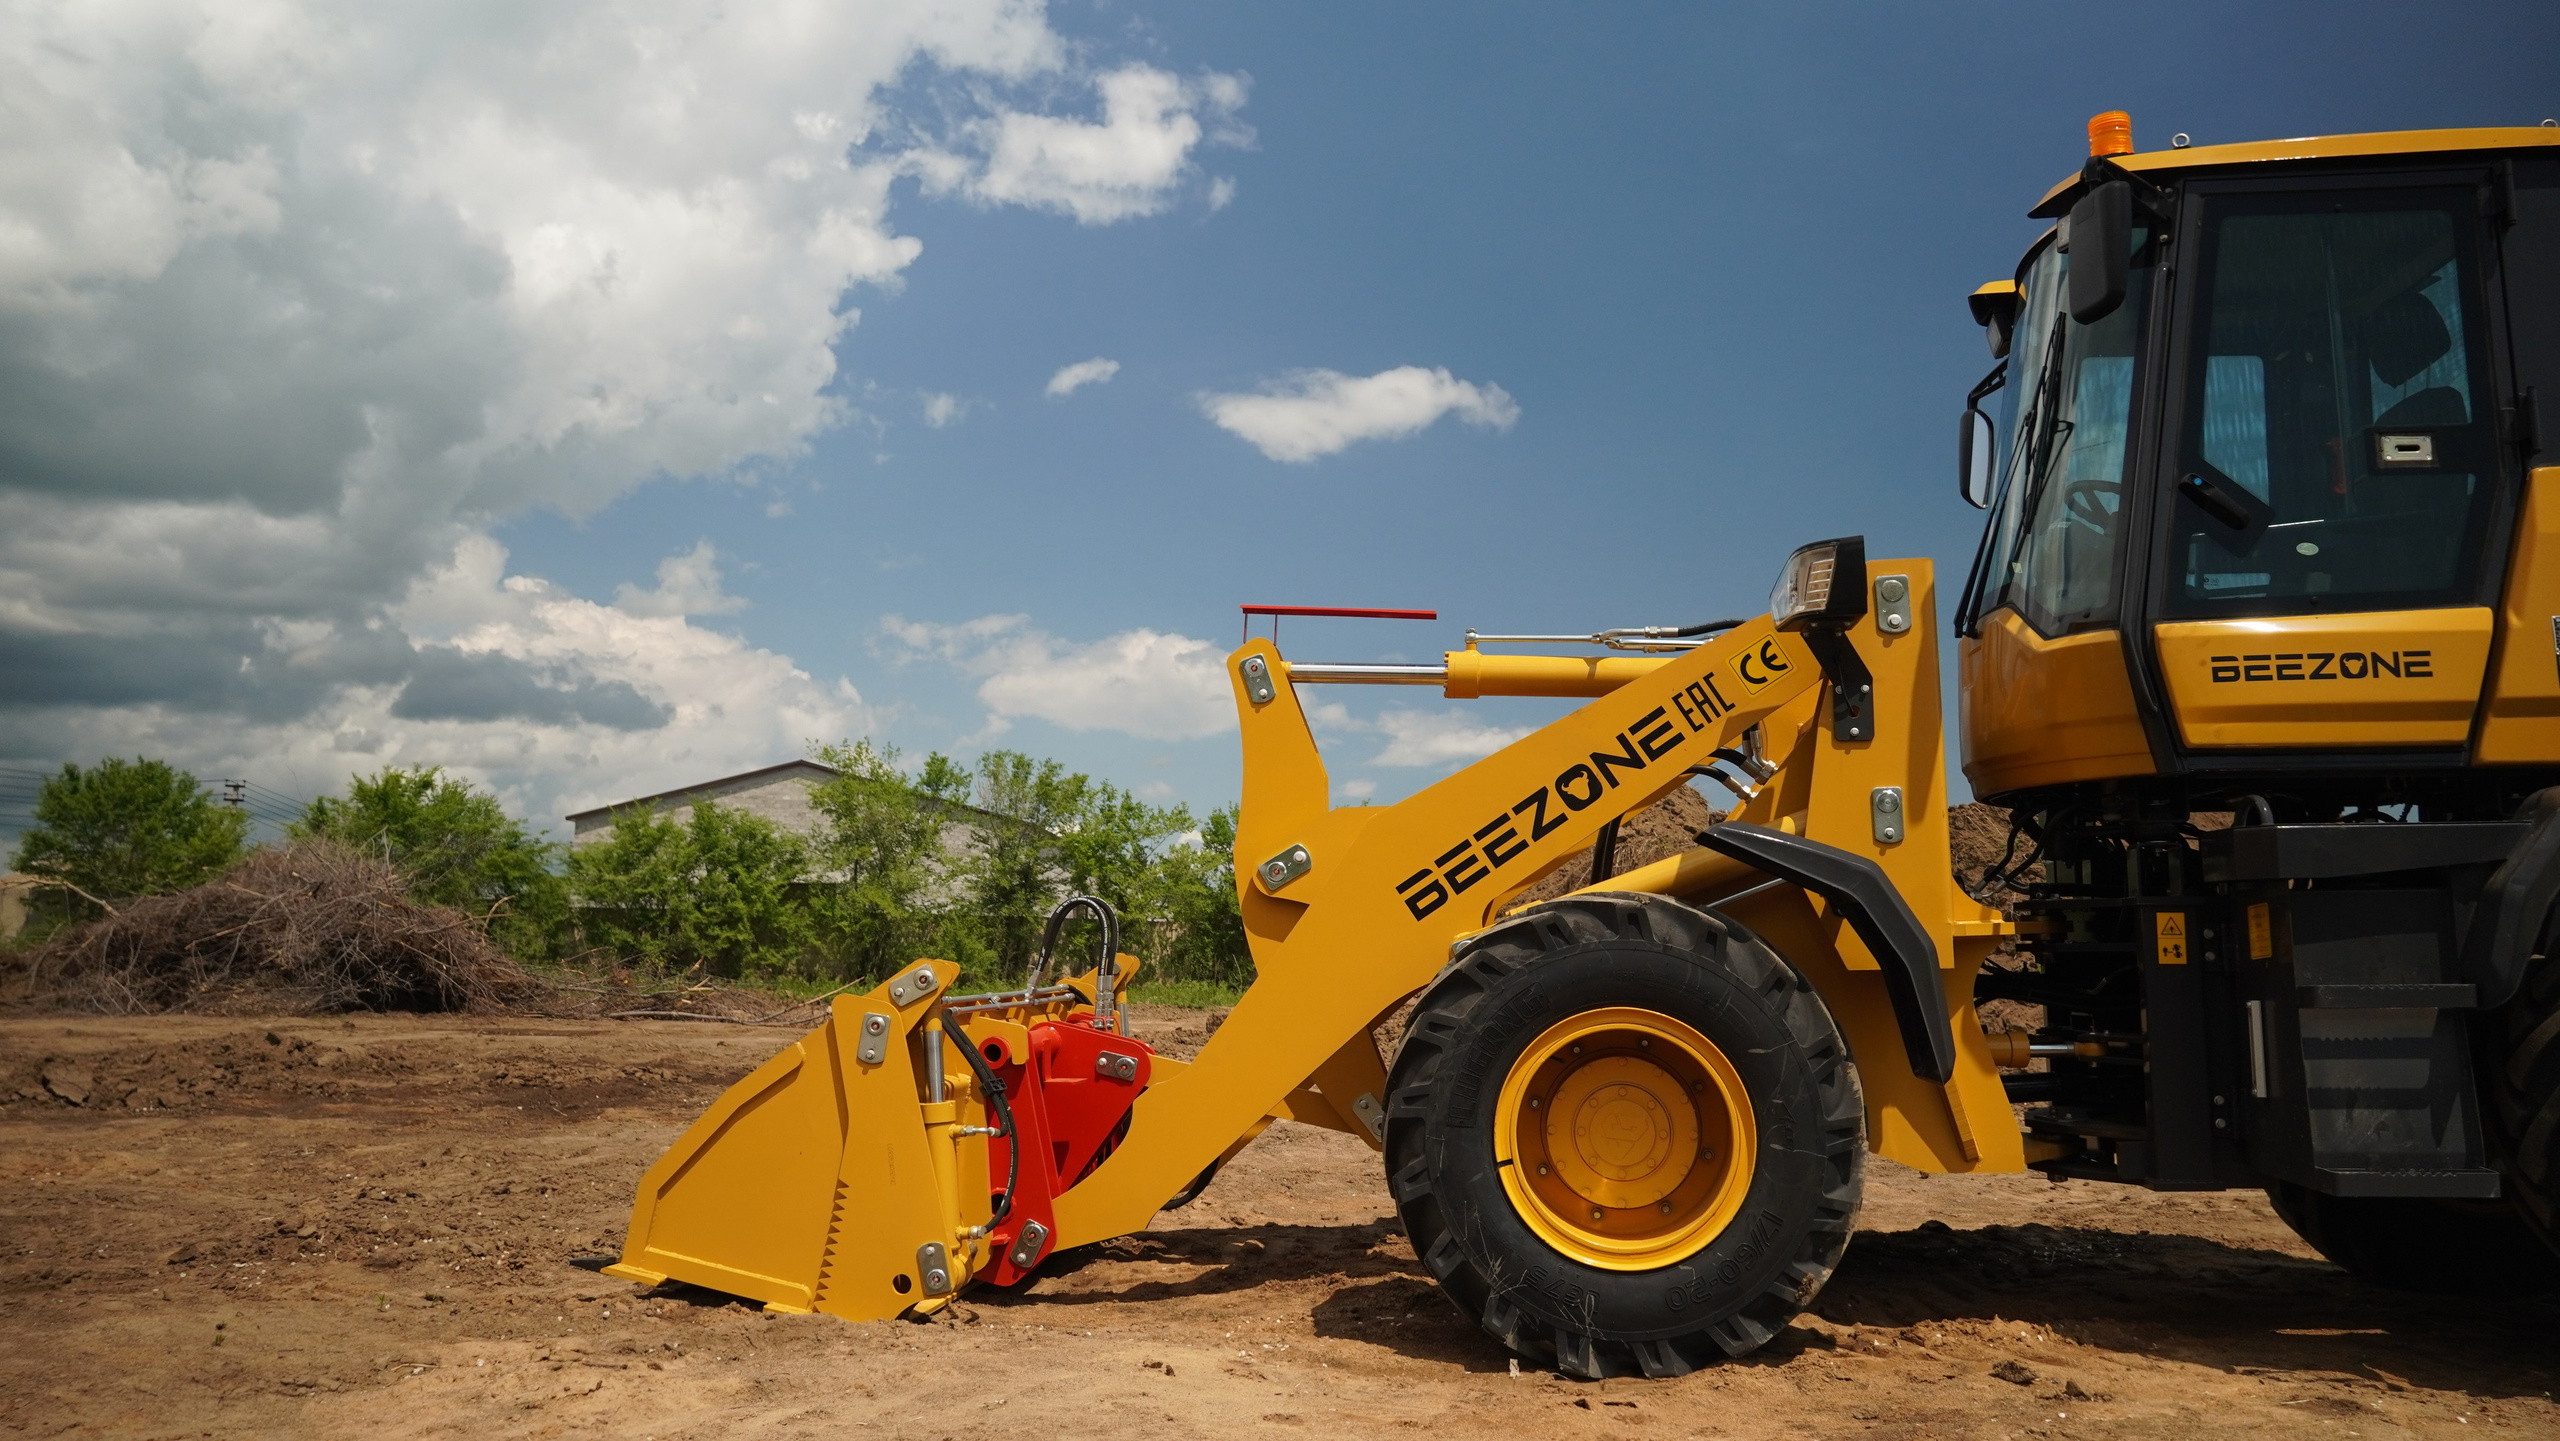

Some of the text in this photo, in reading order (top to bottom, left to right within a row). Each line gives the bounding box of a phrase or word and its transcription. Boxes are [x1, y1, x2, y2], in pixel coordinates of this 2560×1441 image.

[1740, 640, 1788, 684] CE
[2211, 650, 2433, 683] BEEZONE
[1395, 705, 1686, 922] BEEZONE
[1449, 984, 1547, 1120] LUGONG
[1665, 1208, 1784, 1312] 17/60-20
